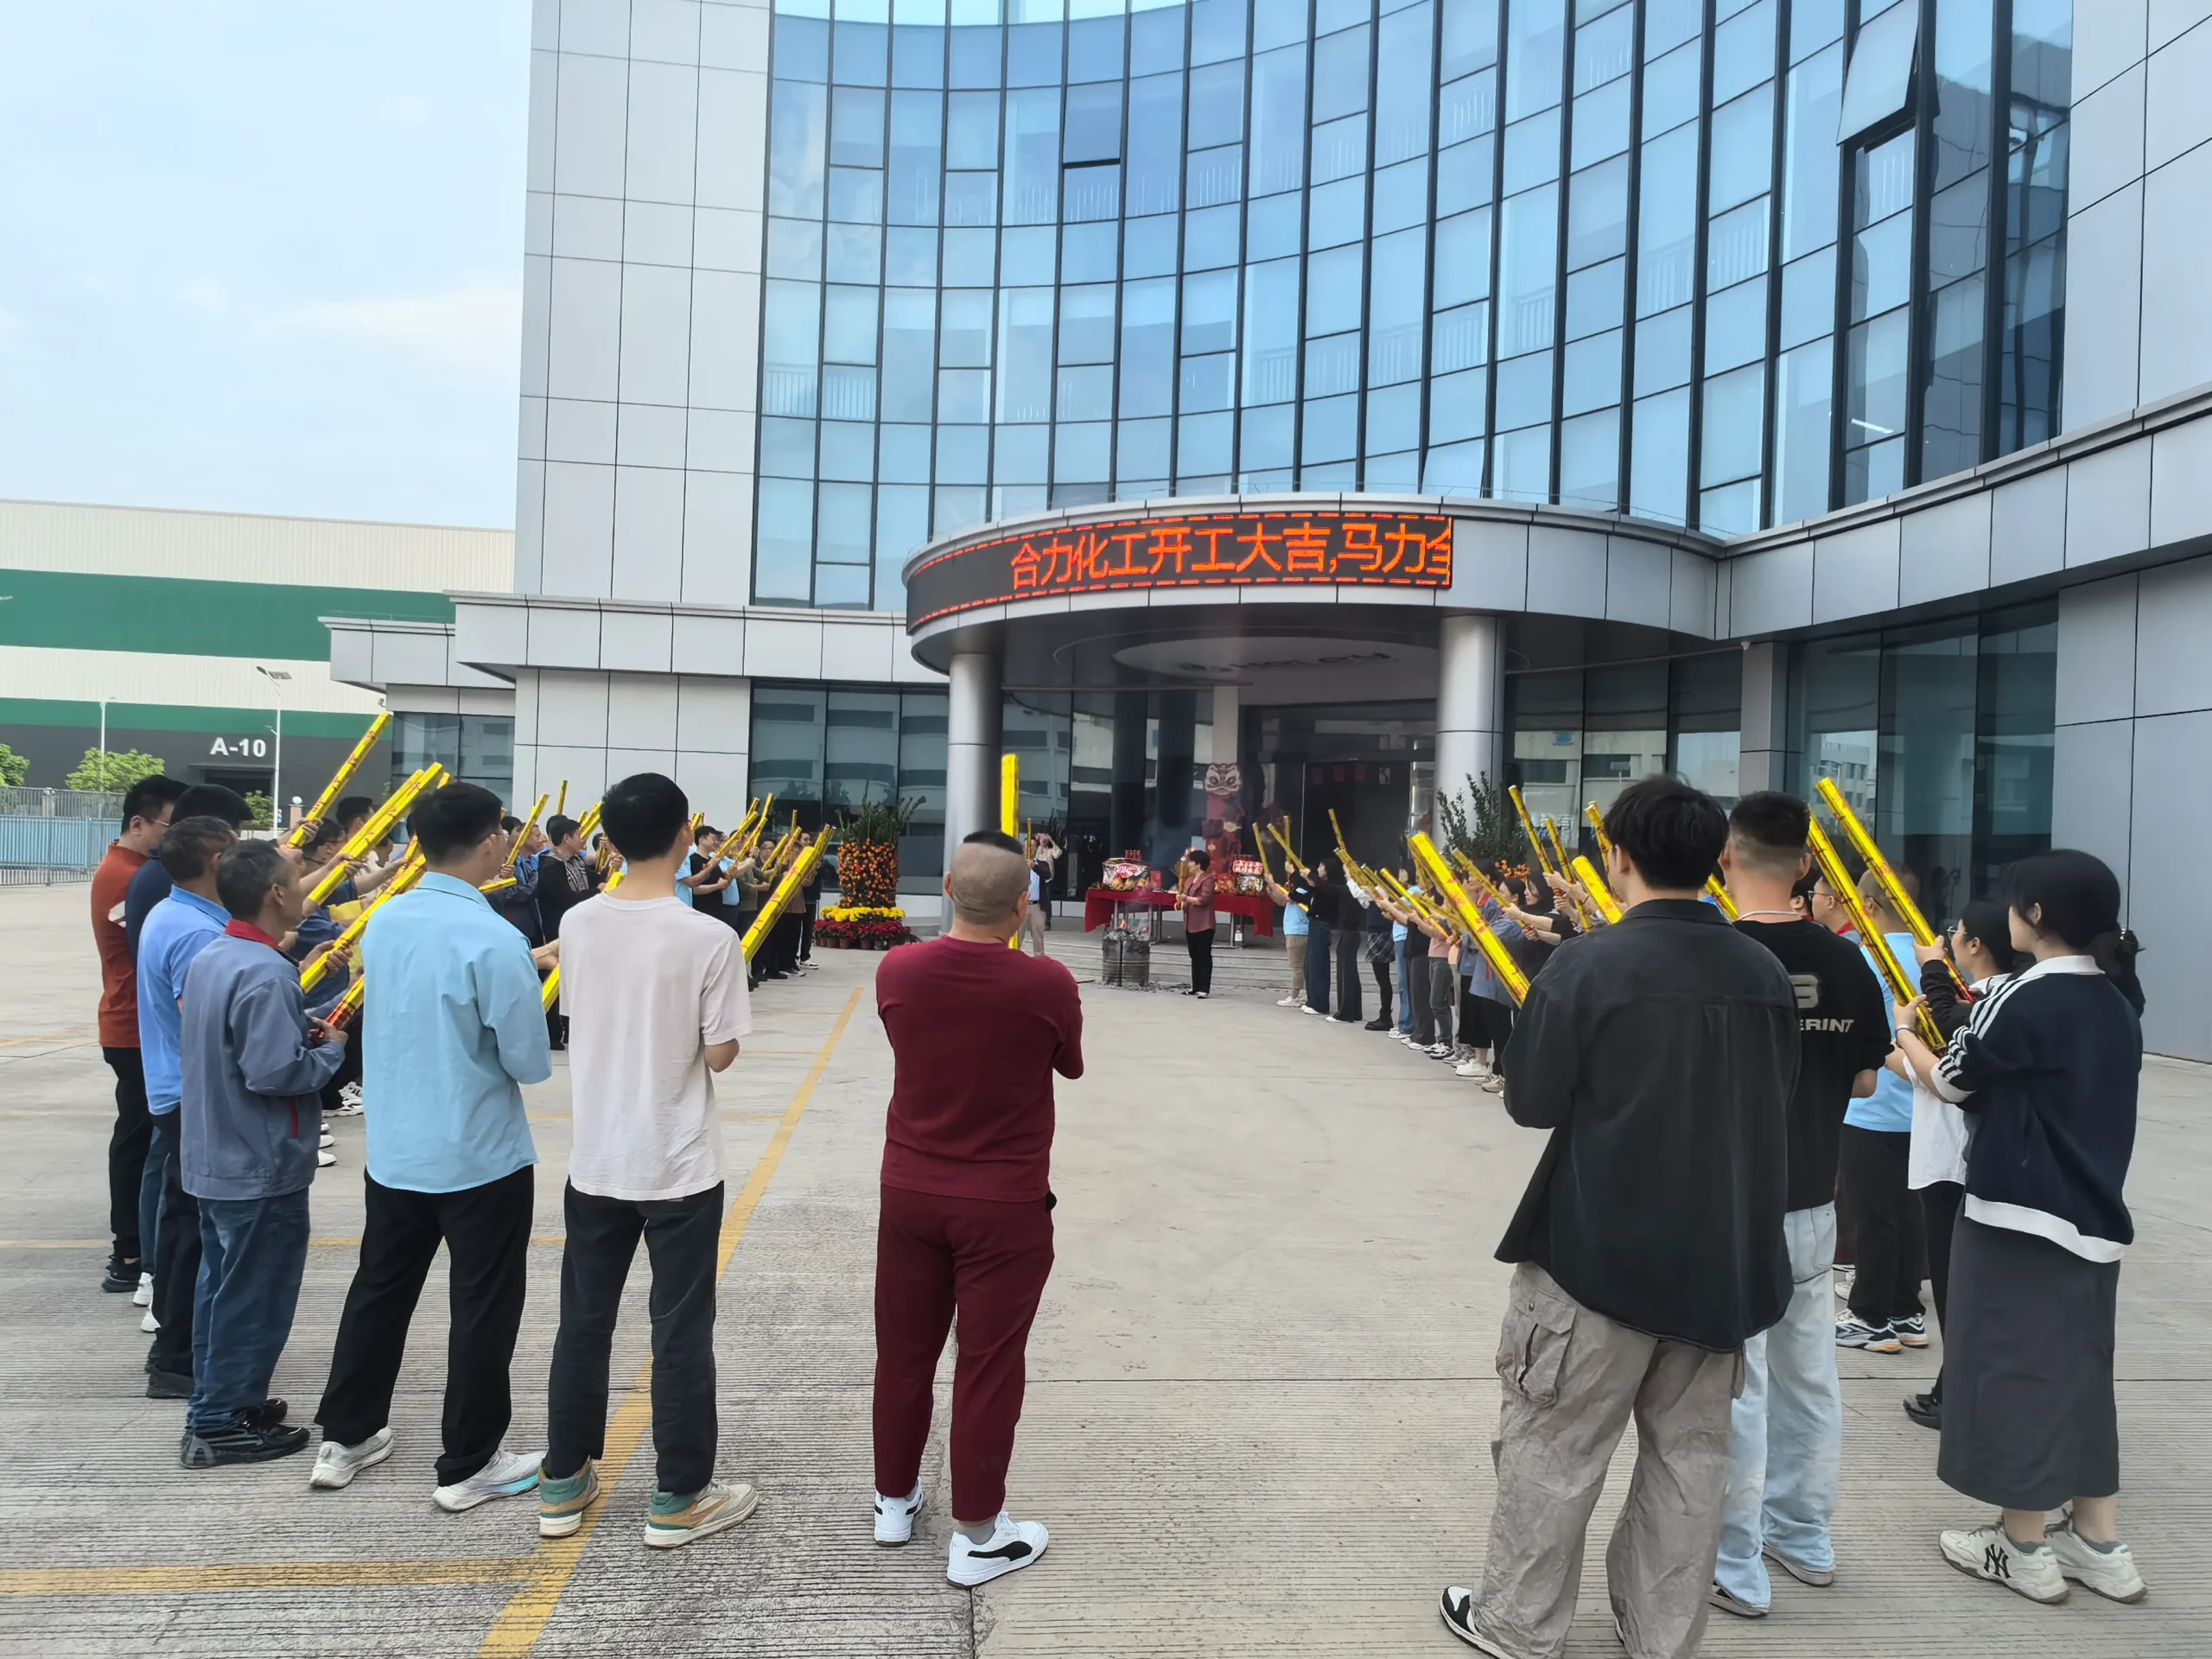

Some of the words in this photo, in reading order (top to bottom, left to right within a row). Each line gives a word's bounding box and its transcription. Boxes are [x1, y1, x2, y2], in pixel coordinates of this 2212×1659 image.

[209, 736, 266, 757] A-10
[1800, 1018, 1854, 1033] RINT
[1984, 1544, 2012, 1579] NY
